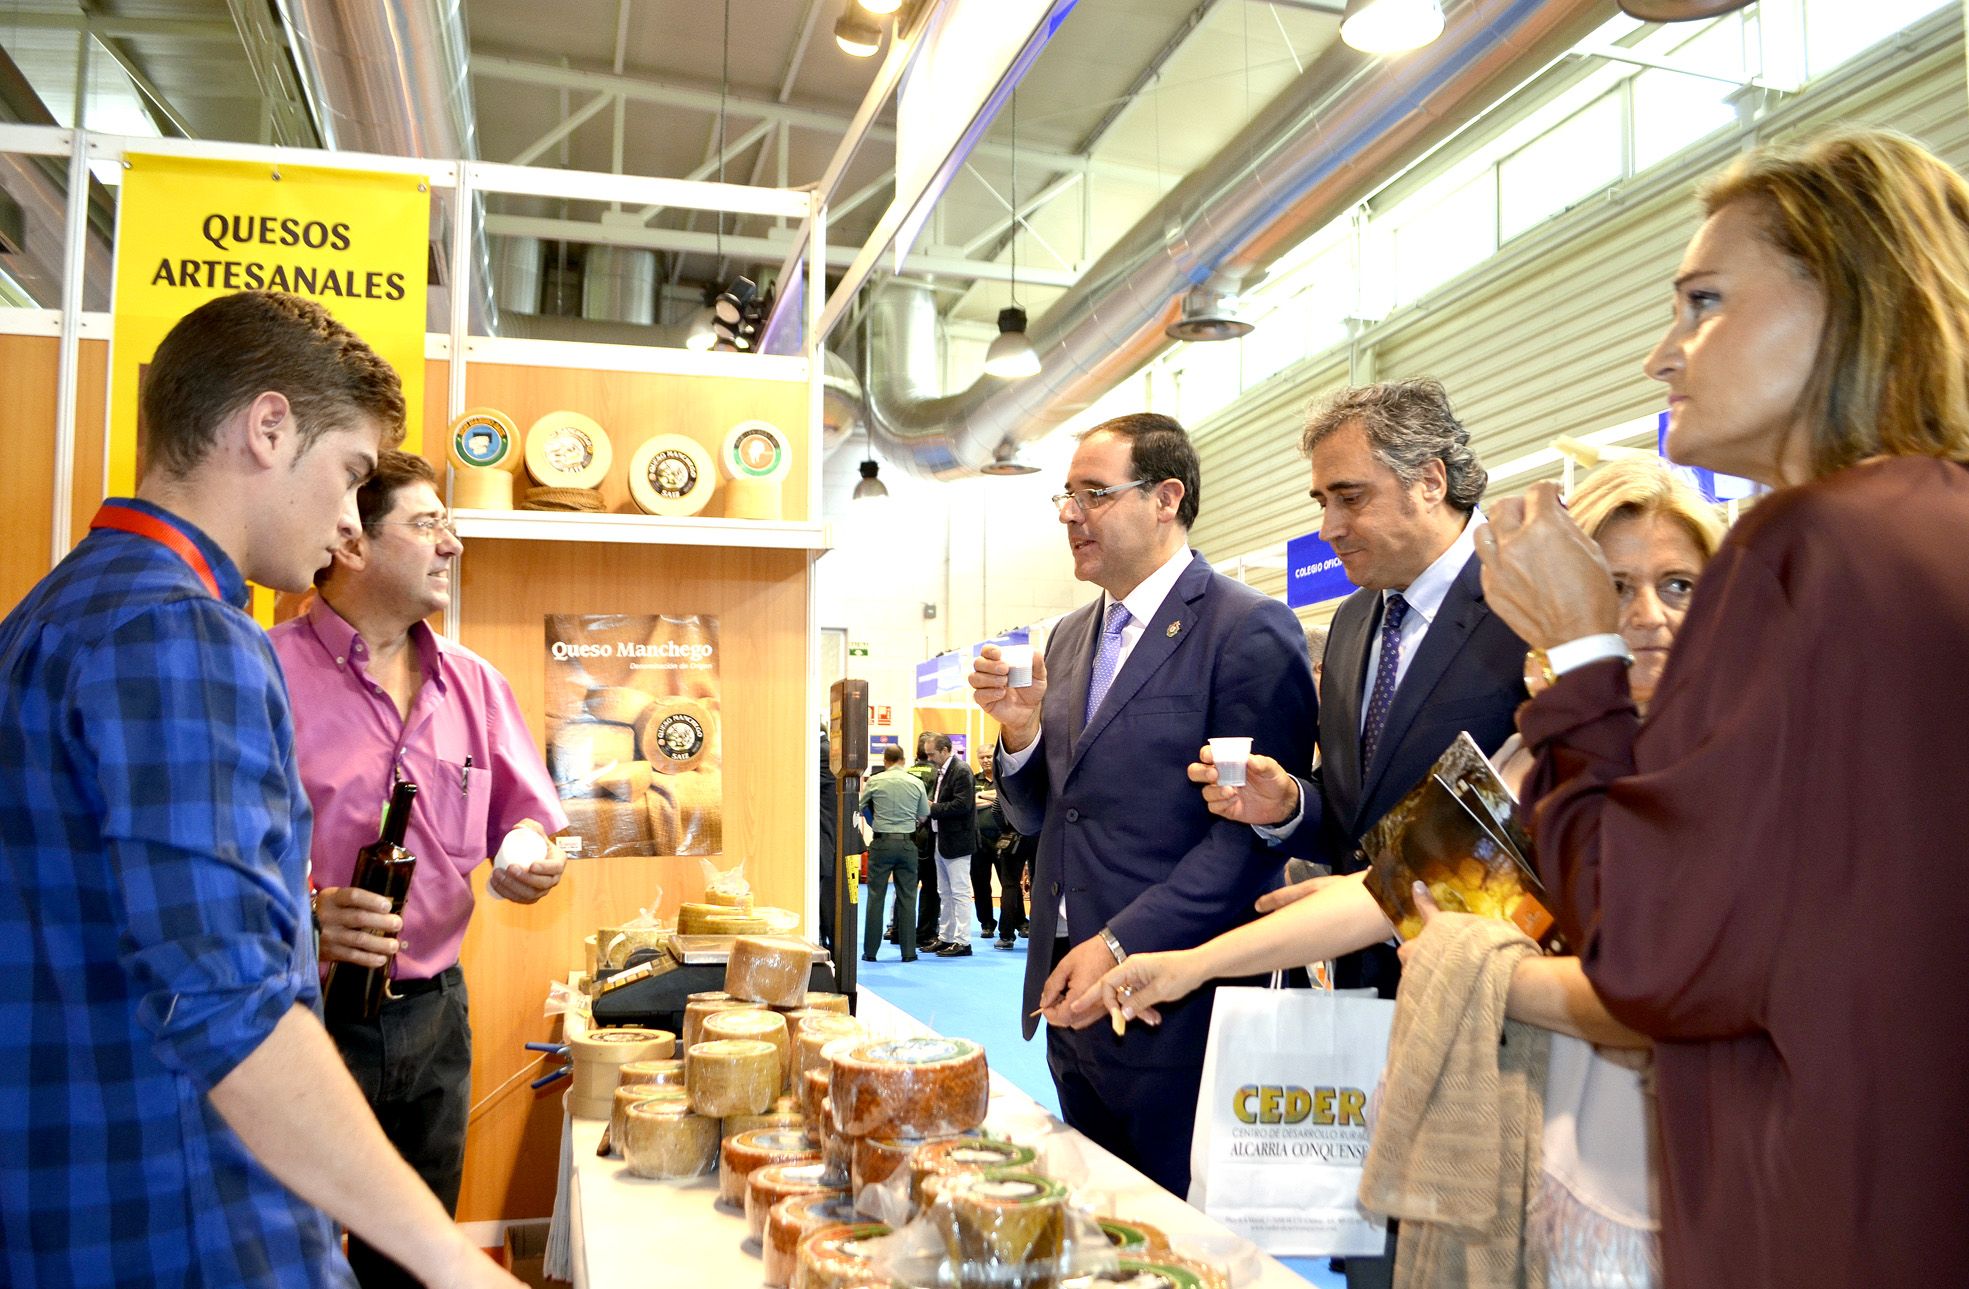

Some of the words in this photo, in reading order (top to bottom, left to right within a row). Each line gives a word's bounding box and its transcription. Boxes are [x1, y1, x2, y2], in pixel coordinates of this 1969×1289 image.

[203, 213, 351, 251] QUESOS
[151, 258, 405, 301] ARTESANALES
[1295, 562, 1323, 579] COLEGIO
[552, 641, 612, 661] Queso
[616, 640, 713, 661] Manchego
[657, 717, 673, 738] QUESO
[672, 714, 703, 738] MANCHEGO
[1233, 1084, 1367, 1126] CEDER
[1232, 1127, 1268, 1138] CENTRO
[1268, 1128, 1281, 1138] DE
[1282, 1128, 1338, 1140] DESARROLLO
[1231, 1142, 1288, 1158] ALCARRIA
